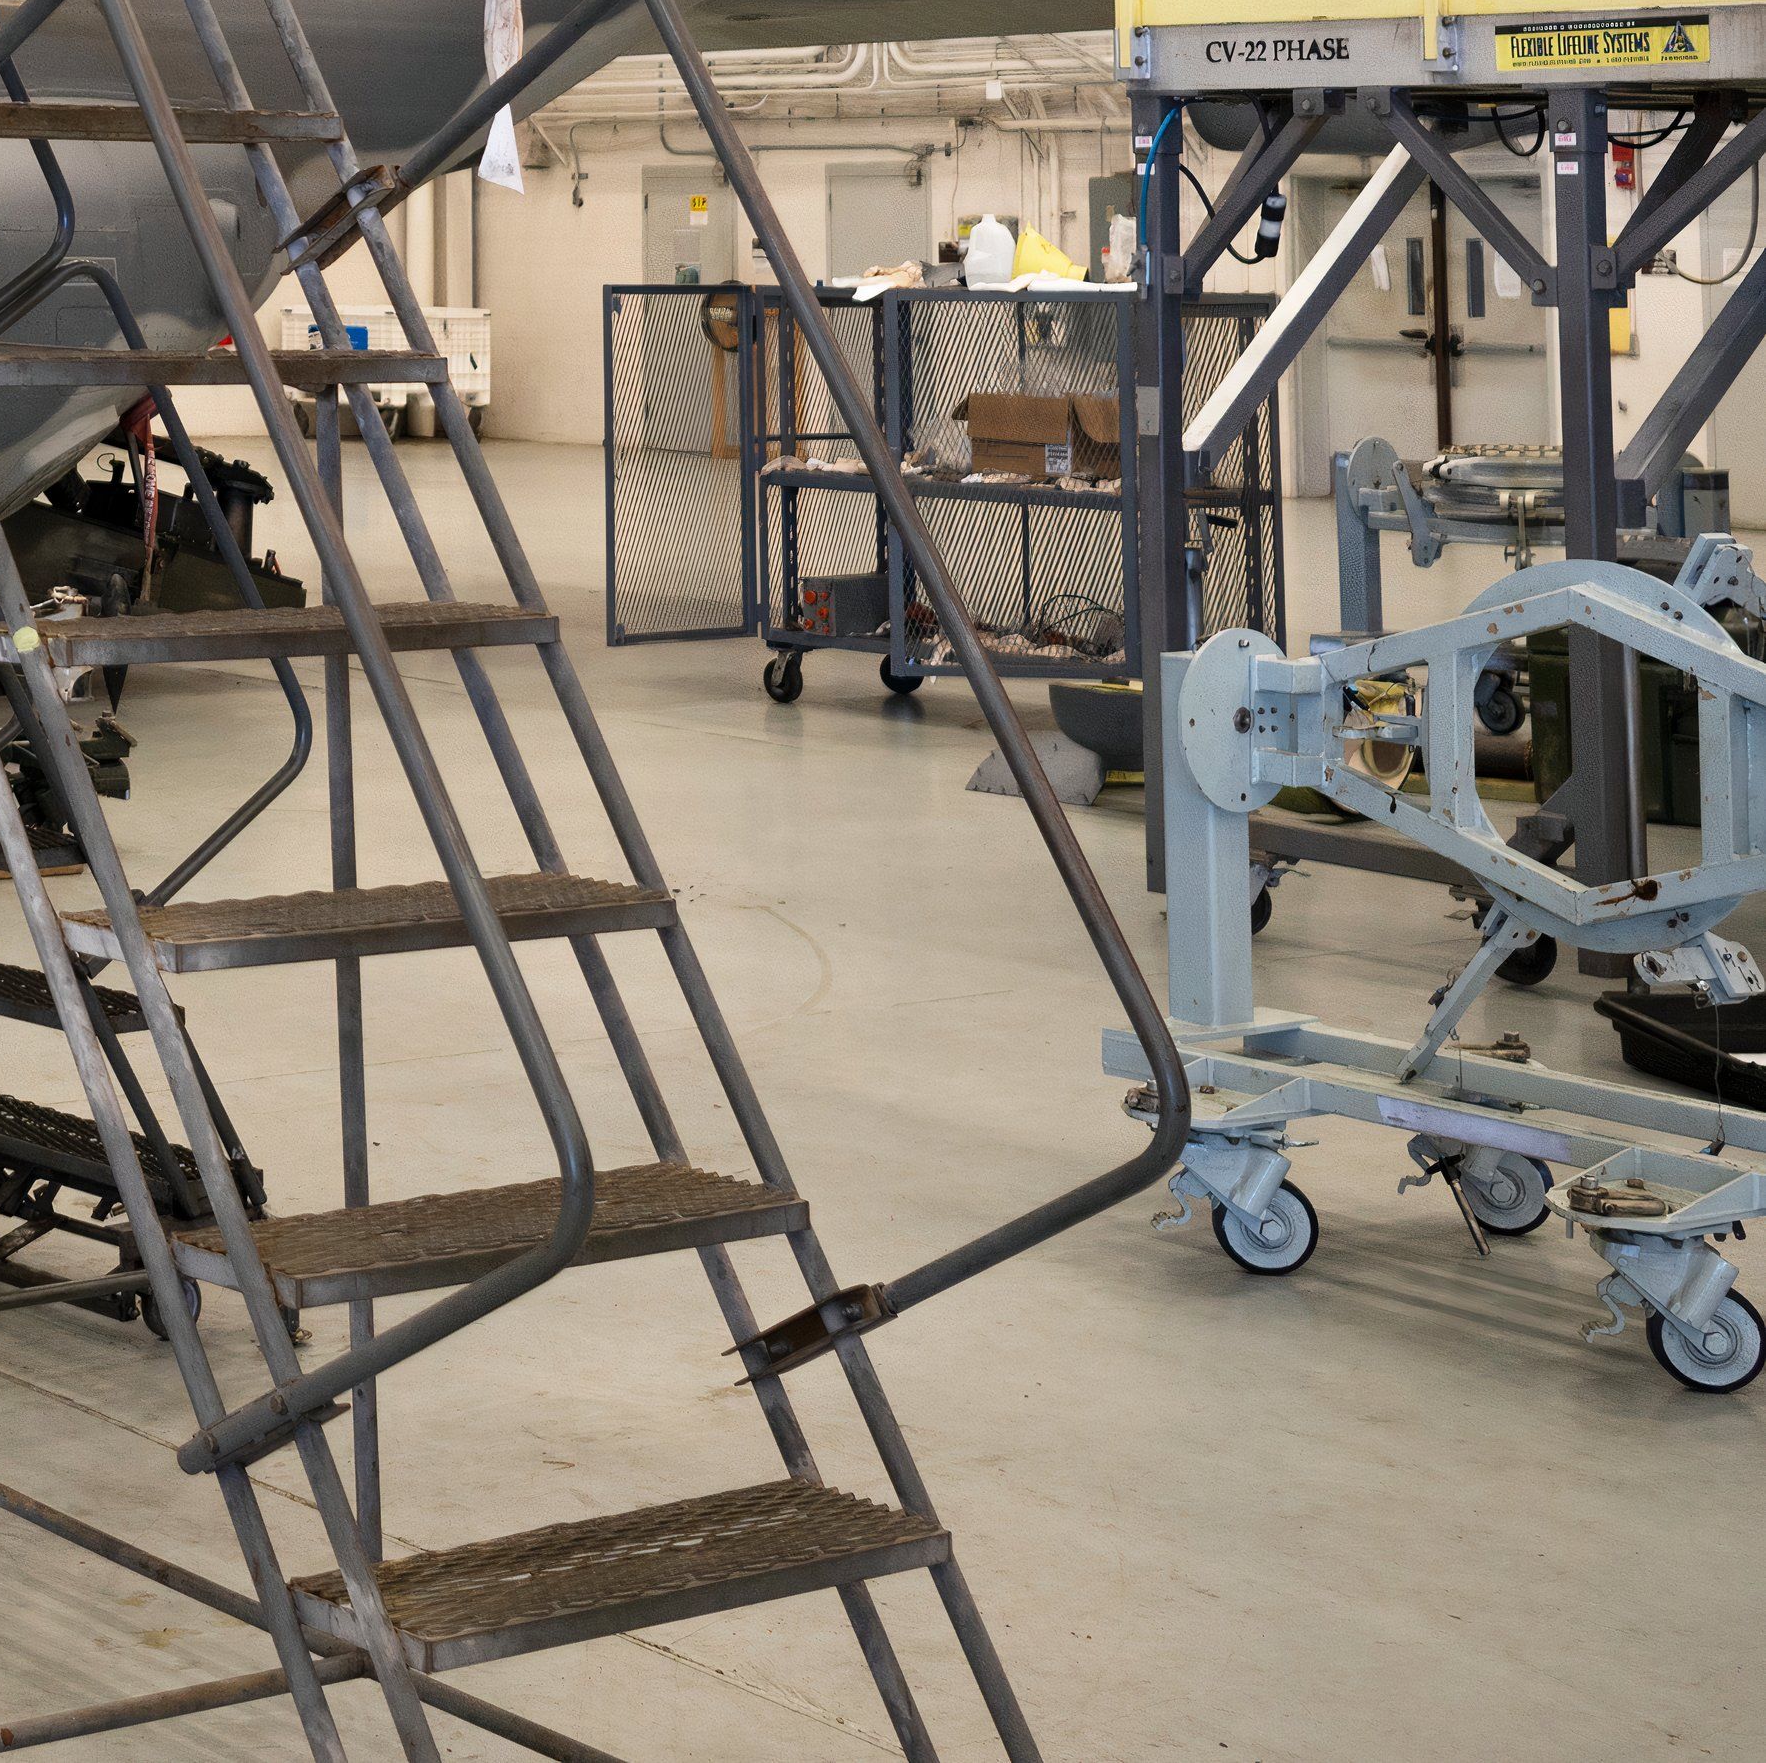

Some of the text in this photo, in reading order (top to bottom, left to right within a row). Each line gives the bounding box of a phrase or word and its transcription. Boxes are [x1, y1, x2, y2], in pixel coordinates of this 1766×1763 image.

[1205, 38, 1350, 63] CV-22 PHASE
[1603, 31, 1650, 54] SYSTEMS
